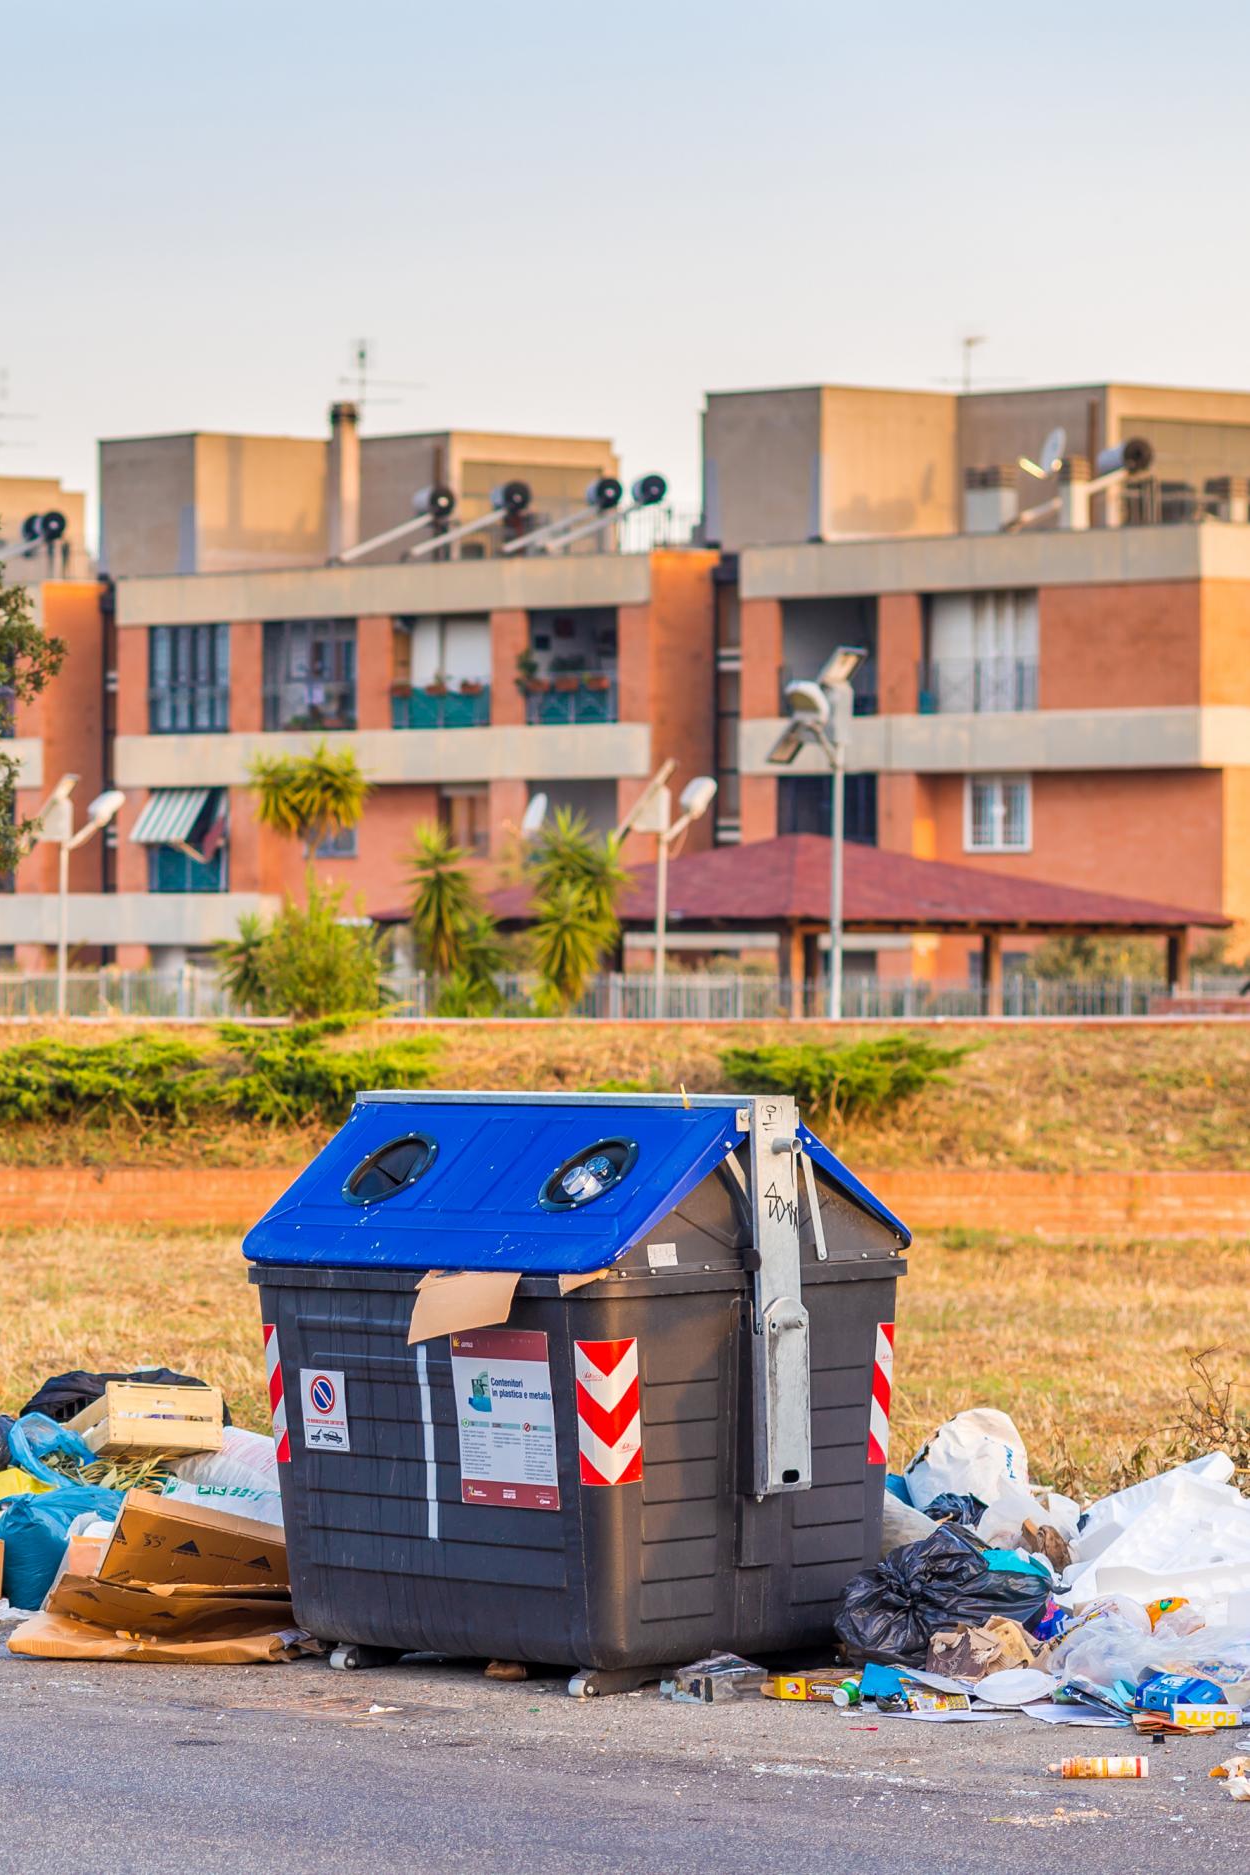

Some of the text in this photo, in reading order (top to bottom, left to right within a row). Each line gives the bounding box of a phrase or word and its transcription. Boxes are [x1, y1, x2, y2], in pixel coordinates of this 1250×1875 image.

[490, 1378, 523, 1388] Contenitori
[492, 1388, 551, 1400] in plastica e metallo
